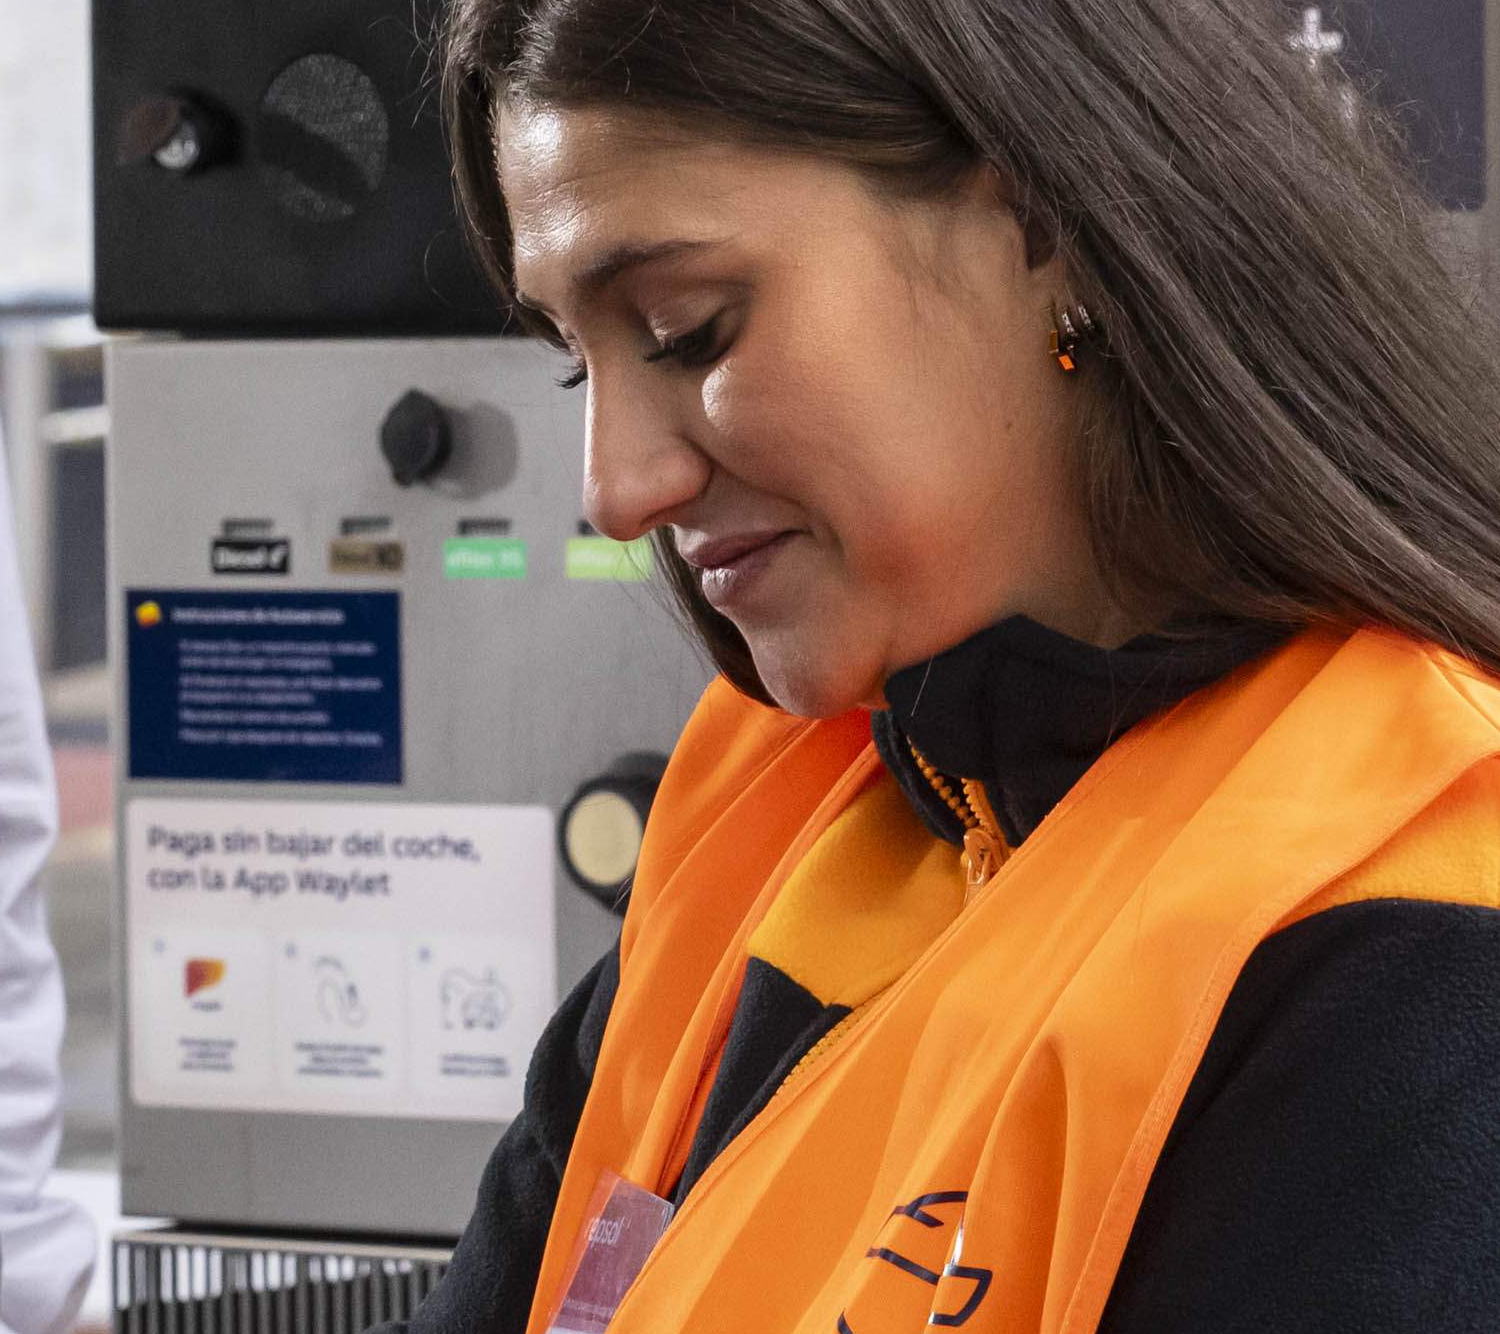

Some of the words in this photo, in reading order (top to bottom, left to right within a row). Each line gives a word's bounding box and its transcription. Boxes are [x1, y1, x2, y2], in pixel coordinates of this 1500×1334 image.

[147, 826, 215, 858] Paga
[221, 829, 260, 854] sin
[265, 830, 335, 860] bajar
[342, 834, 385, 857] del
[392, 835, 482, 863] coche,
[146, 869, 195, 890] con
[201, 868, 227, 891] la
[232, 868, 287, 897] App
[295, 870, 390, 901] Waylet
